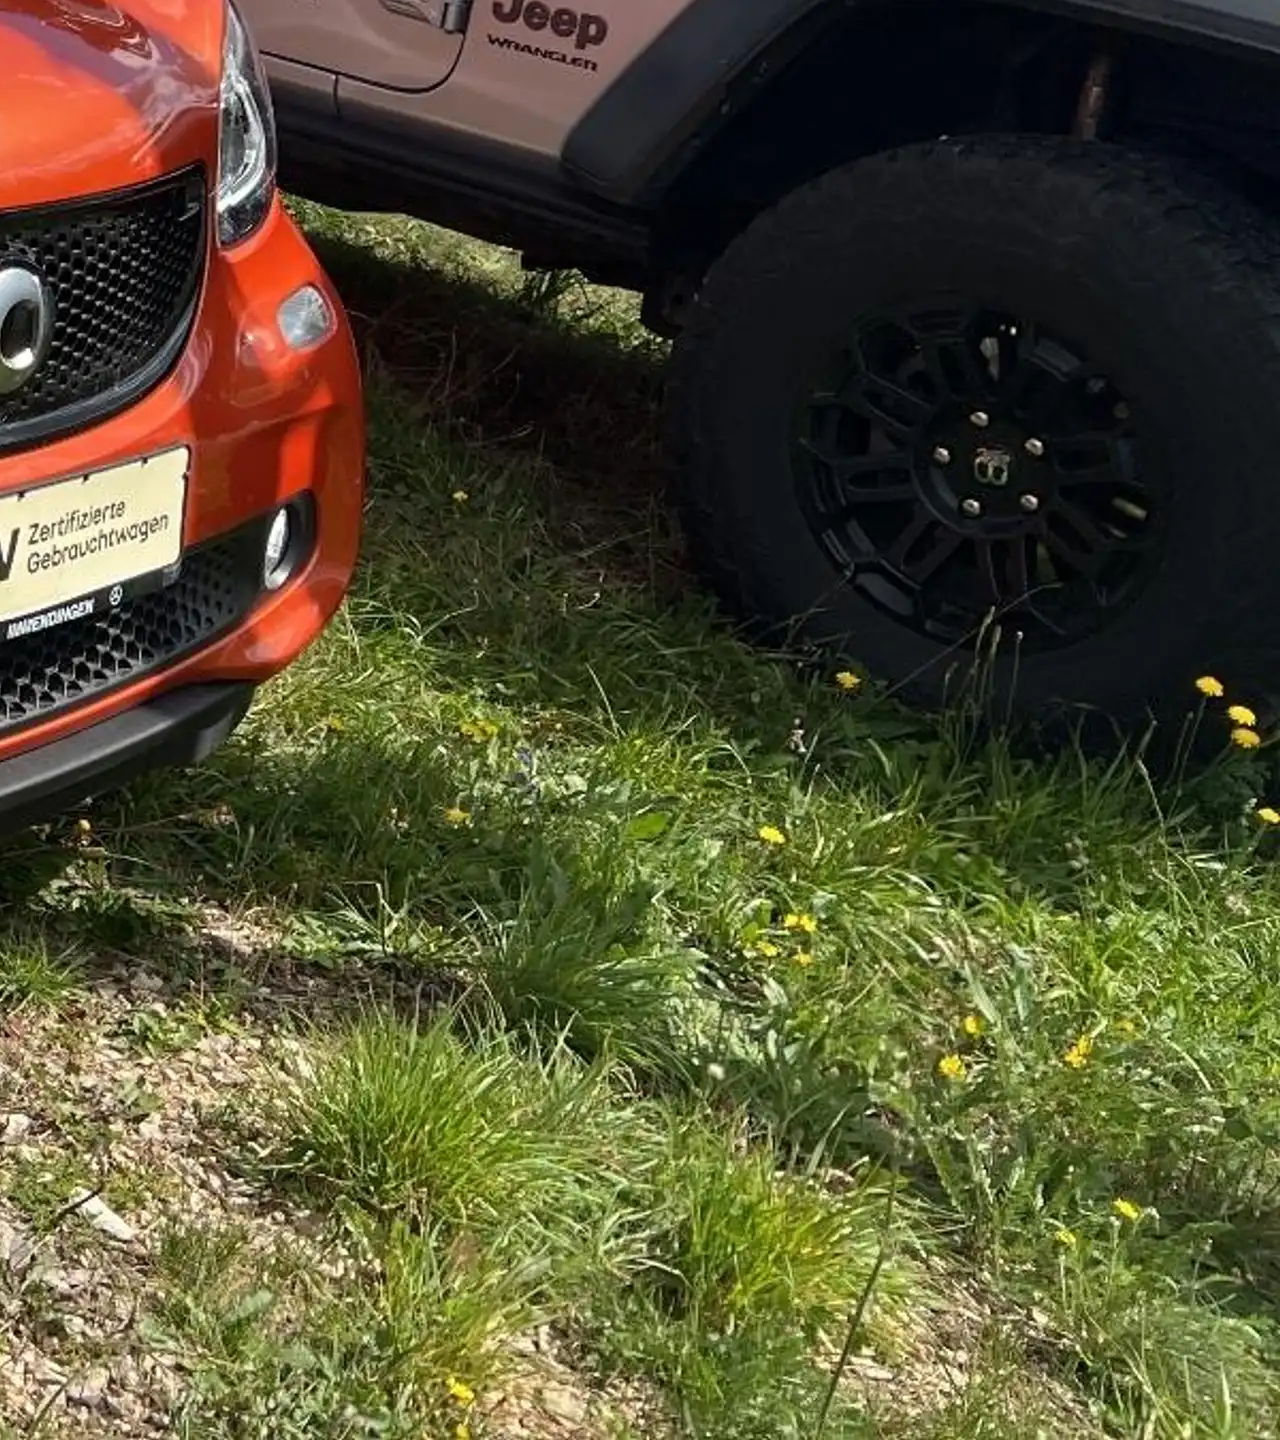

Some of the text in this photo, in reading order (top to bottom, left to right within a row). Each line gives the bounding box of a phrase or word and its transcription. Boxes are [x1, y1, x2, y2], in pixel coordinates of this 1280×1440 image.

[486, 33, 598, 72] WRANGLER
[26, 513, 170, 575] Gebrauchtwagen
[27, 500, 127, 546] Zertifizierte
